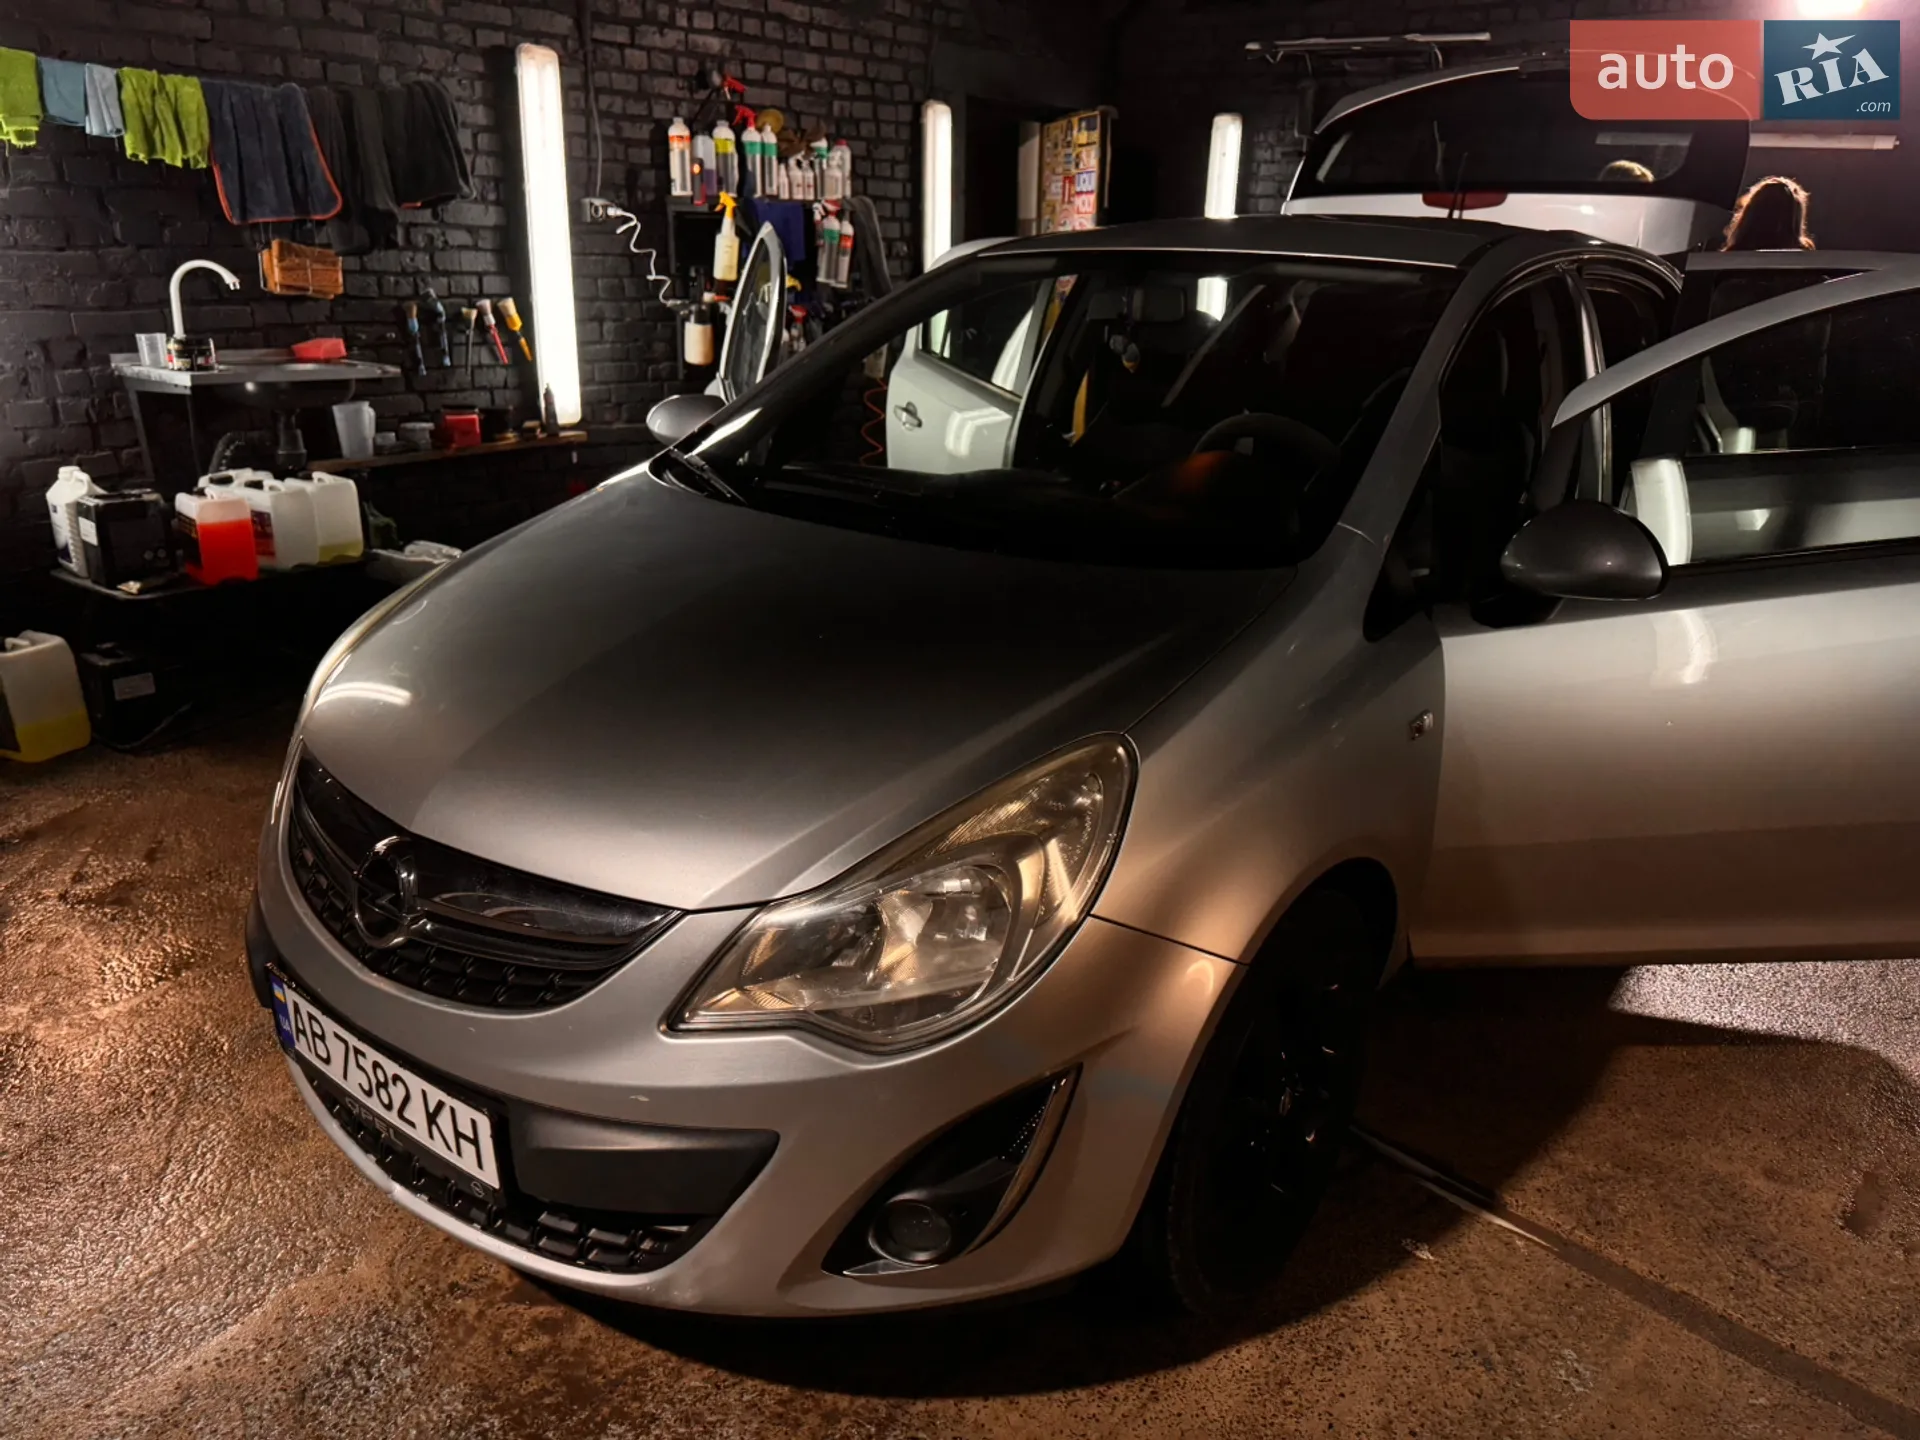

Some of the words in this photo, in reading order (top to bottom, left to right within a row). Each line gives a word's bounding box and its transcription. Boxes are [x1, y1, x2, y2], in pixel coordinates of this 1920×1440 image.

[292, 999, 331, 1065] AB
[333, 1030, 417, 1129] 7582
[421, 1088, 485, 1171] KH
